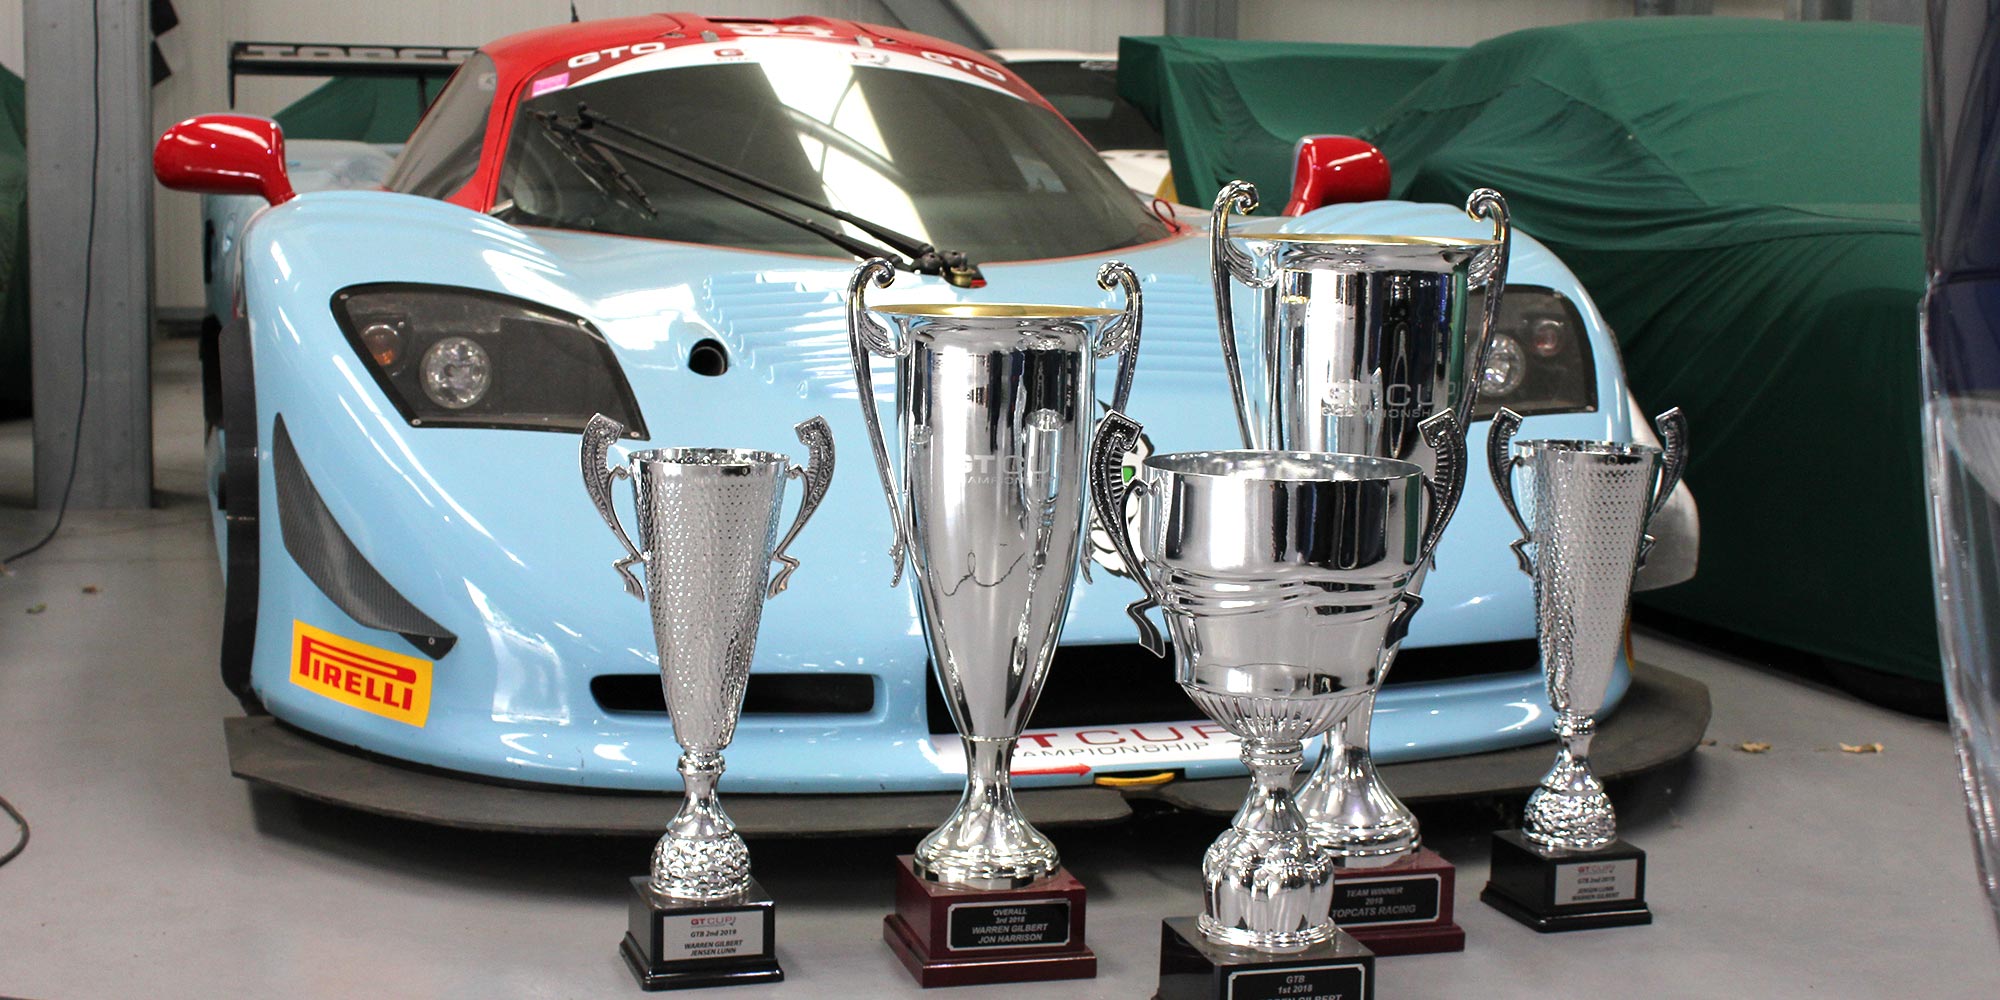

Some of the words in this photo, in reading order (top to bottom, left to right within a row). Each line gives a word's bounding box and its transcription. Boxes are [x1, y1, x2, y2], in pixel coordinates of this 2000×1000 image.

[567, 42, 666, 68] GTO
[920, 51, 1007, 81] GTO
[299, 634, 417, 711] PIRELLI
[1014, 733, 1058, 748] T
[1012, 741, 1209, 757] AMPIONSHIP
[1346, 889, 1369, 898] TEAM
[1370, 887, 1404, 896] WINNER
[993, 908, 1028, 916] OVERALL
[1332, 907, 1376, 918] TOPCATS
[1377, 905, 1417, 915] RACING
[690, 918, 706, 926] GT
[707, 916, 733, 924] CUP
[972, 925, 1009, 935] WARREN
[1011, 923, 1049, 932] GILBERT
[684, 941, 713, 949] WARREN
[714, 939, 743, 947] GILBERT
[977, 936, 996, 944] JON
[997, 933, 1043, 943] HARRISON
[1286, 975, 1306, 984] GTB
[1278, 986, 1292, 994] 1st
